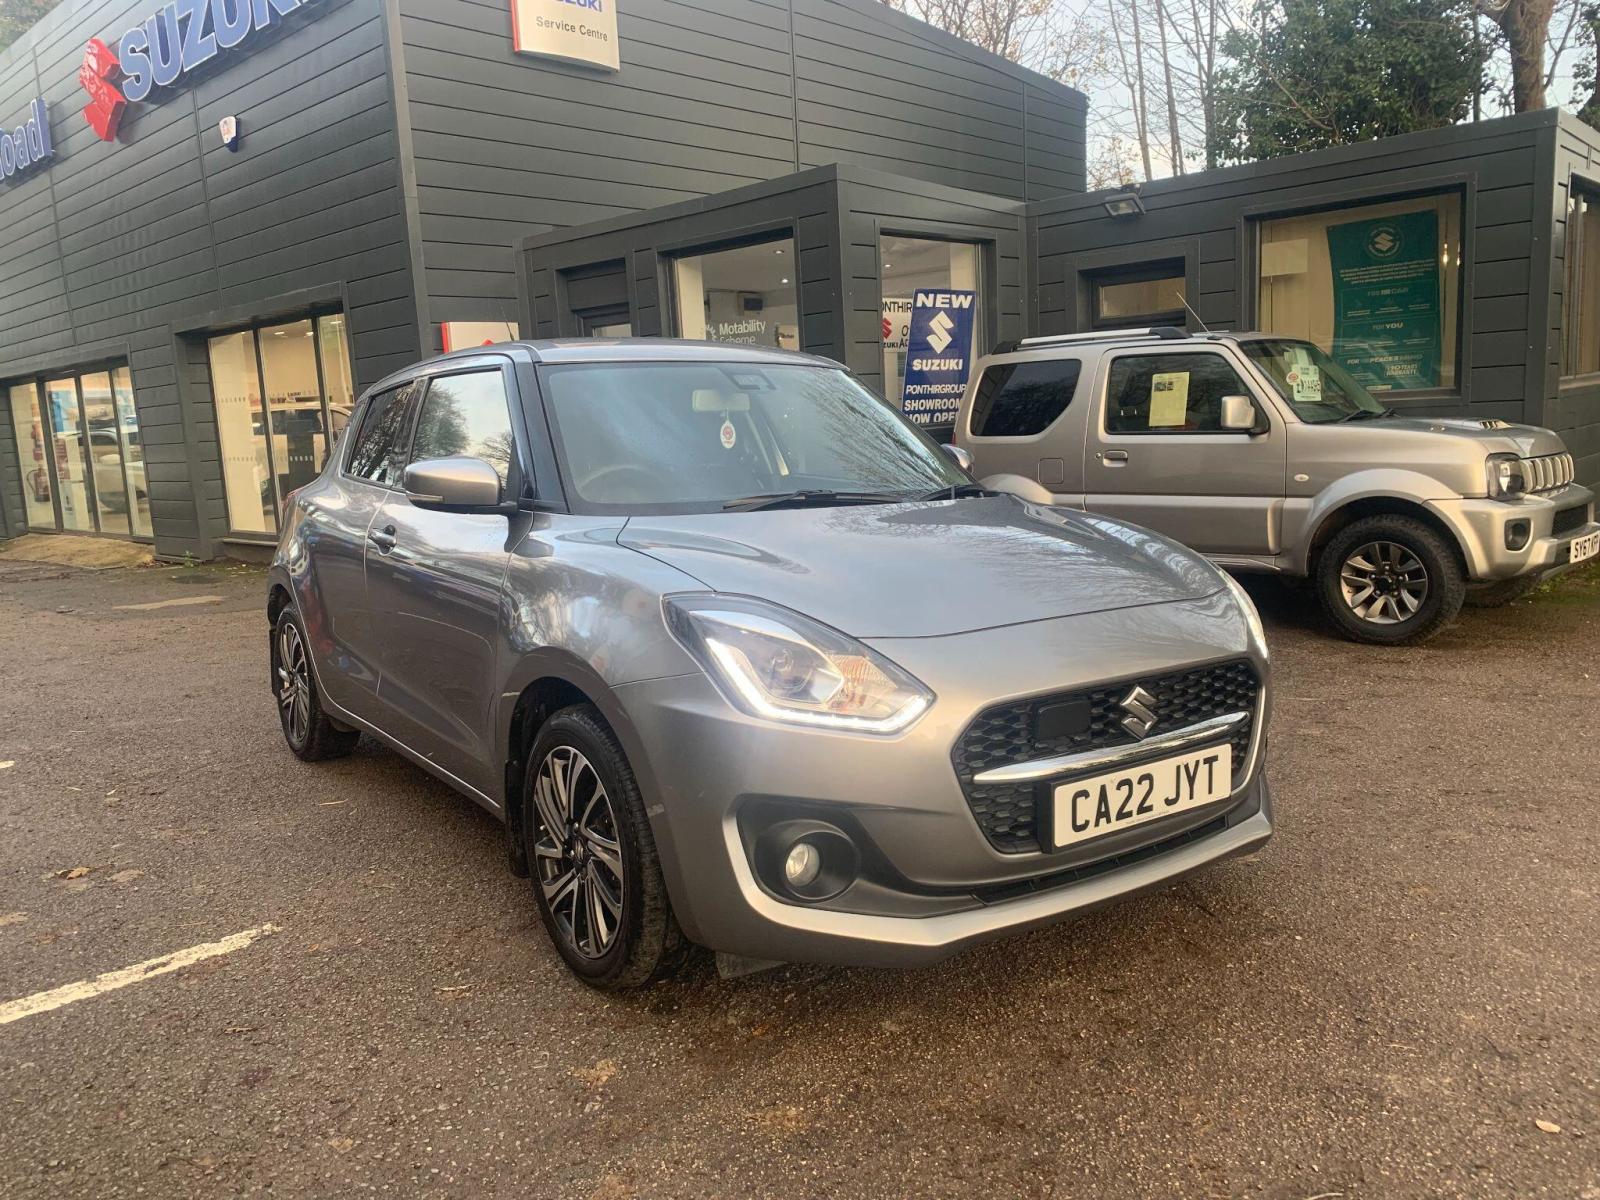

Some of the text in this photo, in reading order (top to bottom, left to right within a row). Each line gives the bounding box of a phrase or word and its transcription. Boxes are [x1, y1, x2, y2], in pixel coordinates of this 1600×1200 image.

[536, 16, 608, 42] Service Centre
[0, 98, 45, 180] oad
[916, 293, 973, 309] NEW
[719, 320, 766, 334] Motability
[912, 358, 963, 372] SUZUKI
[1071, 754, 1219, 833] CA22 JYT
